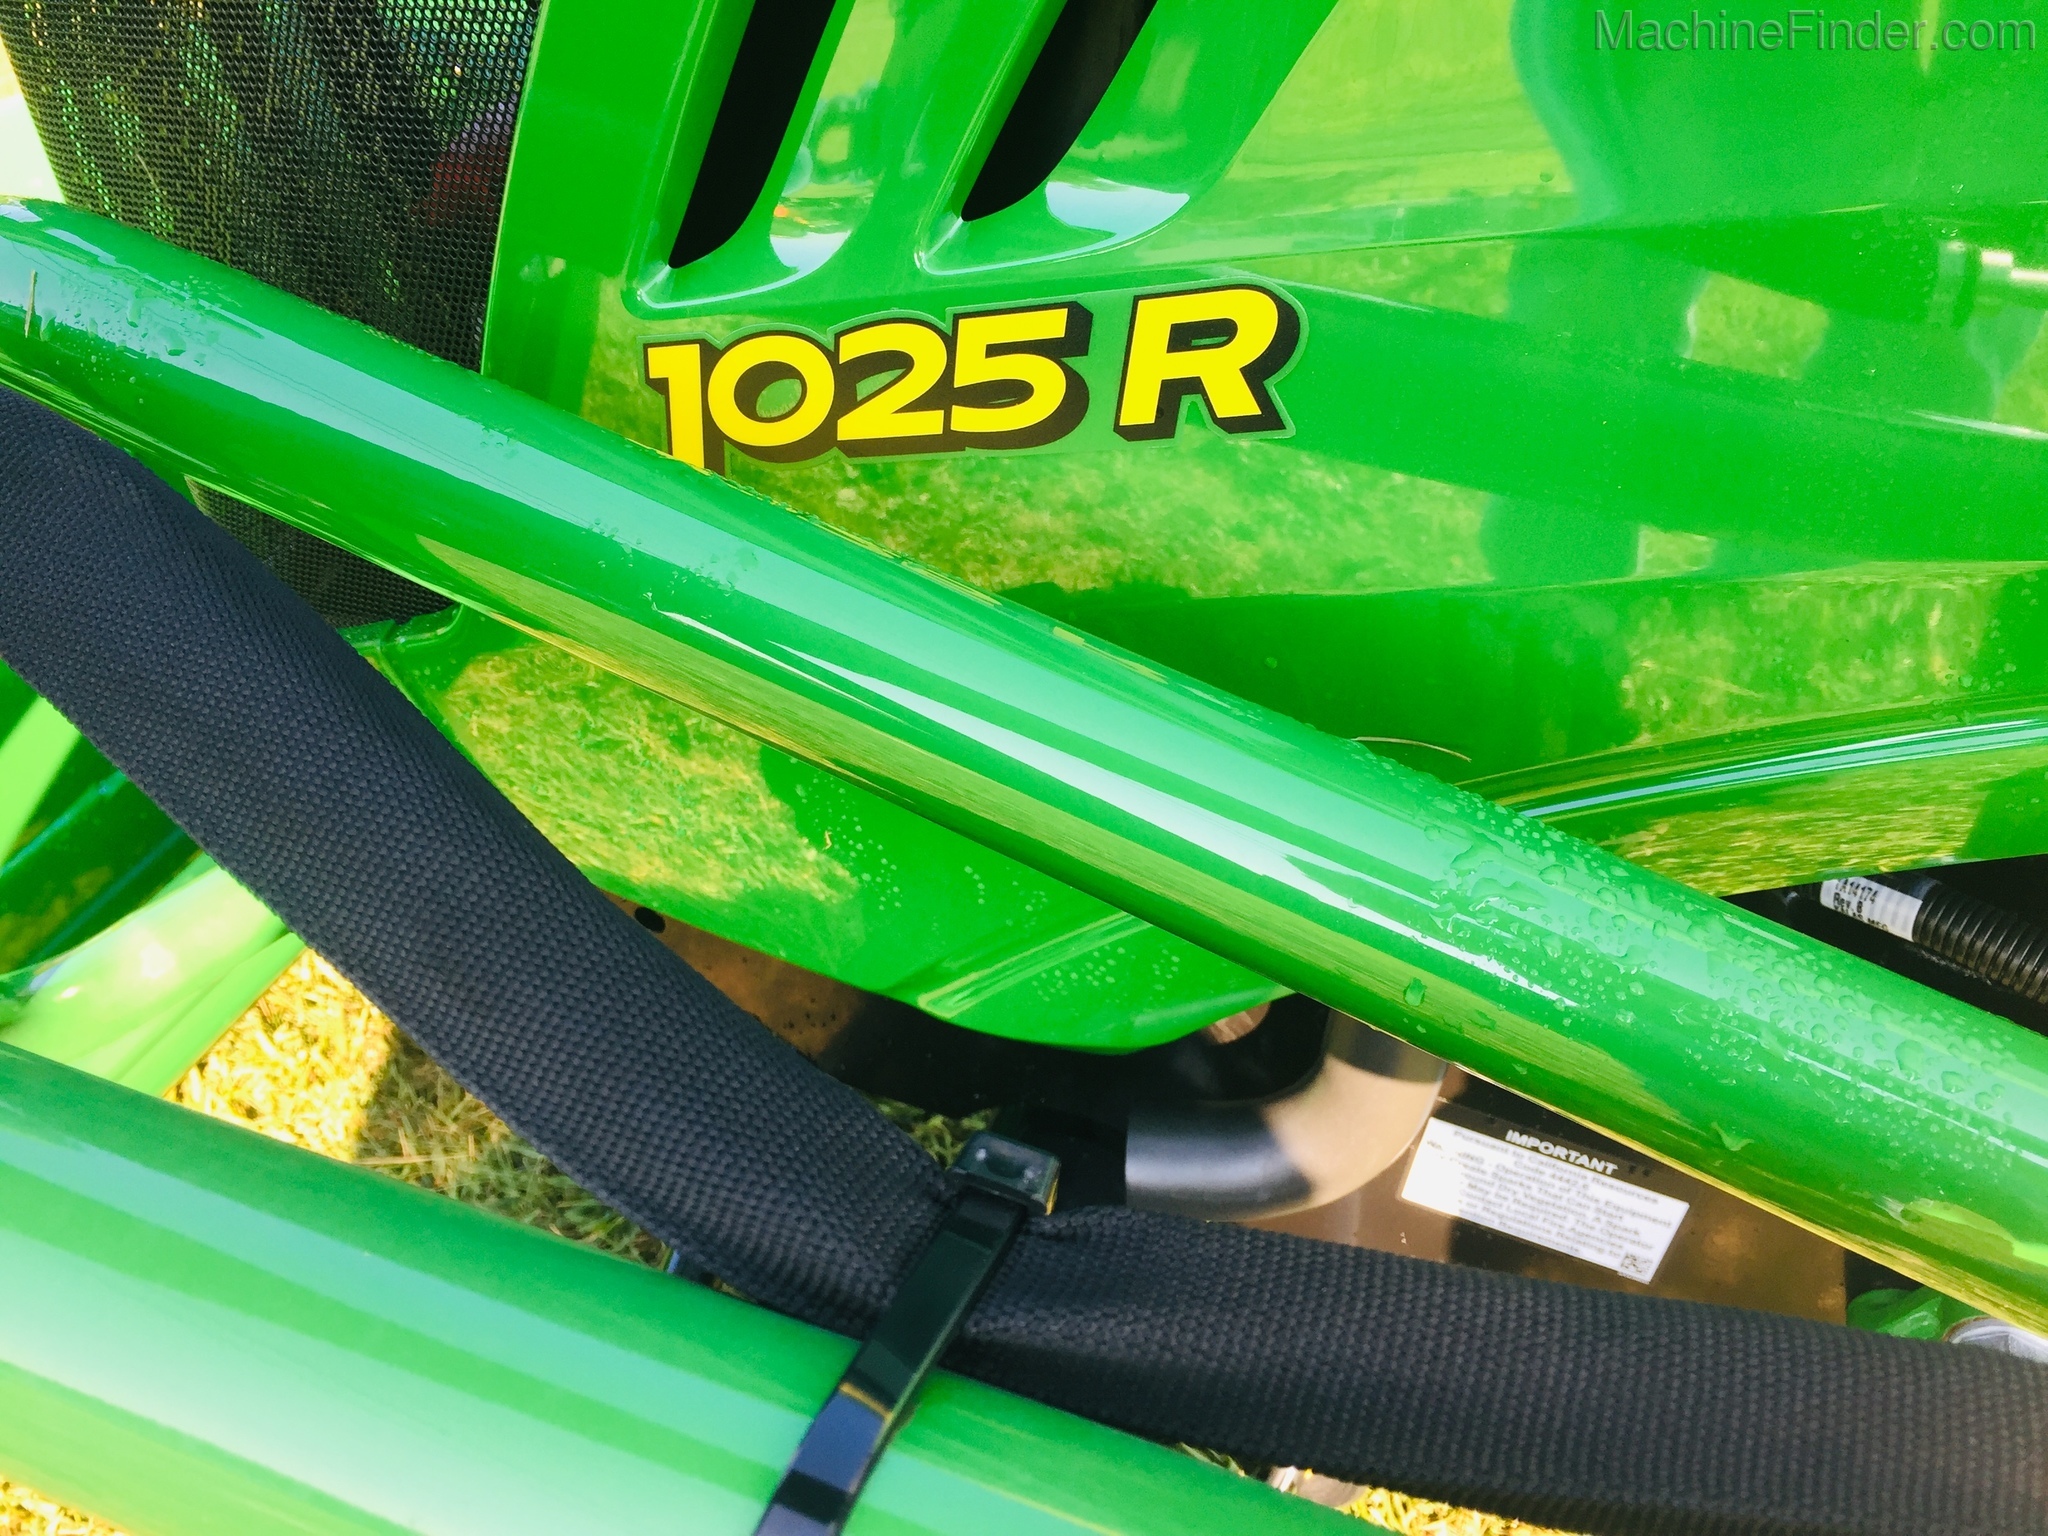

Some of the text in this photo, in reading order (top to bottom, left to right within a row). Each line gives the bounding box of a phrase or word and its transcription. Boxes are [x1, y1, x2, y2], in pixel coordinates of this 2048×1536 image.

[643, 284, 1302, 474] 1025 R
[1505, 1129, 1618, 1176] IMPORTANT
